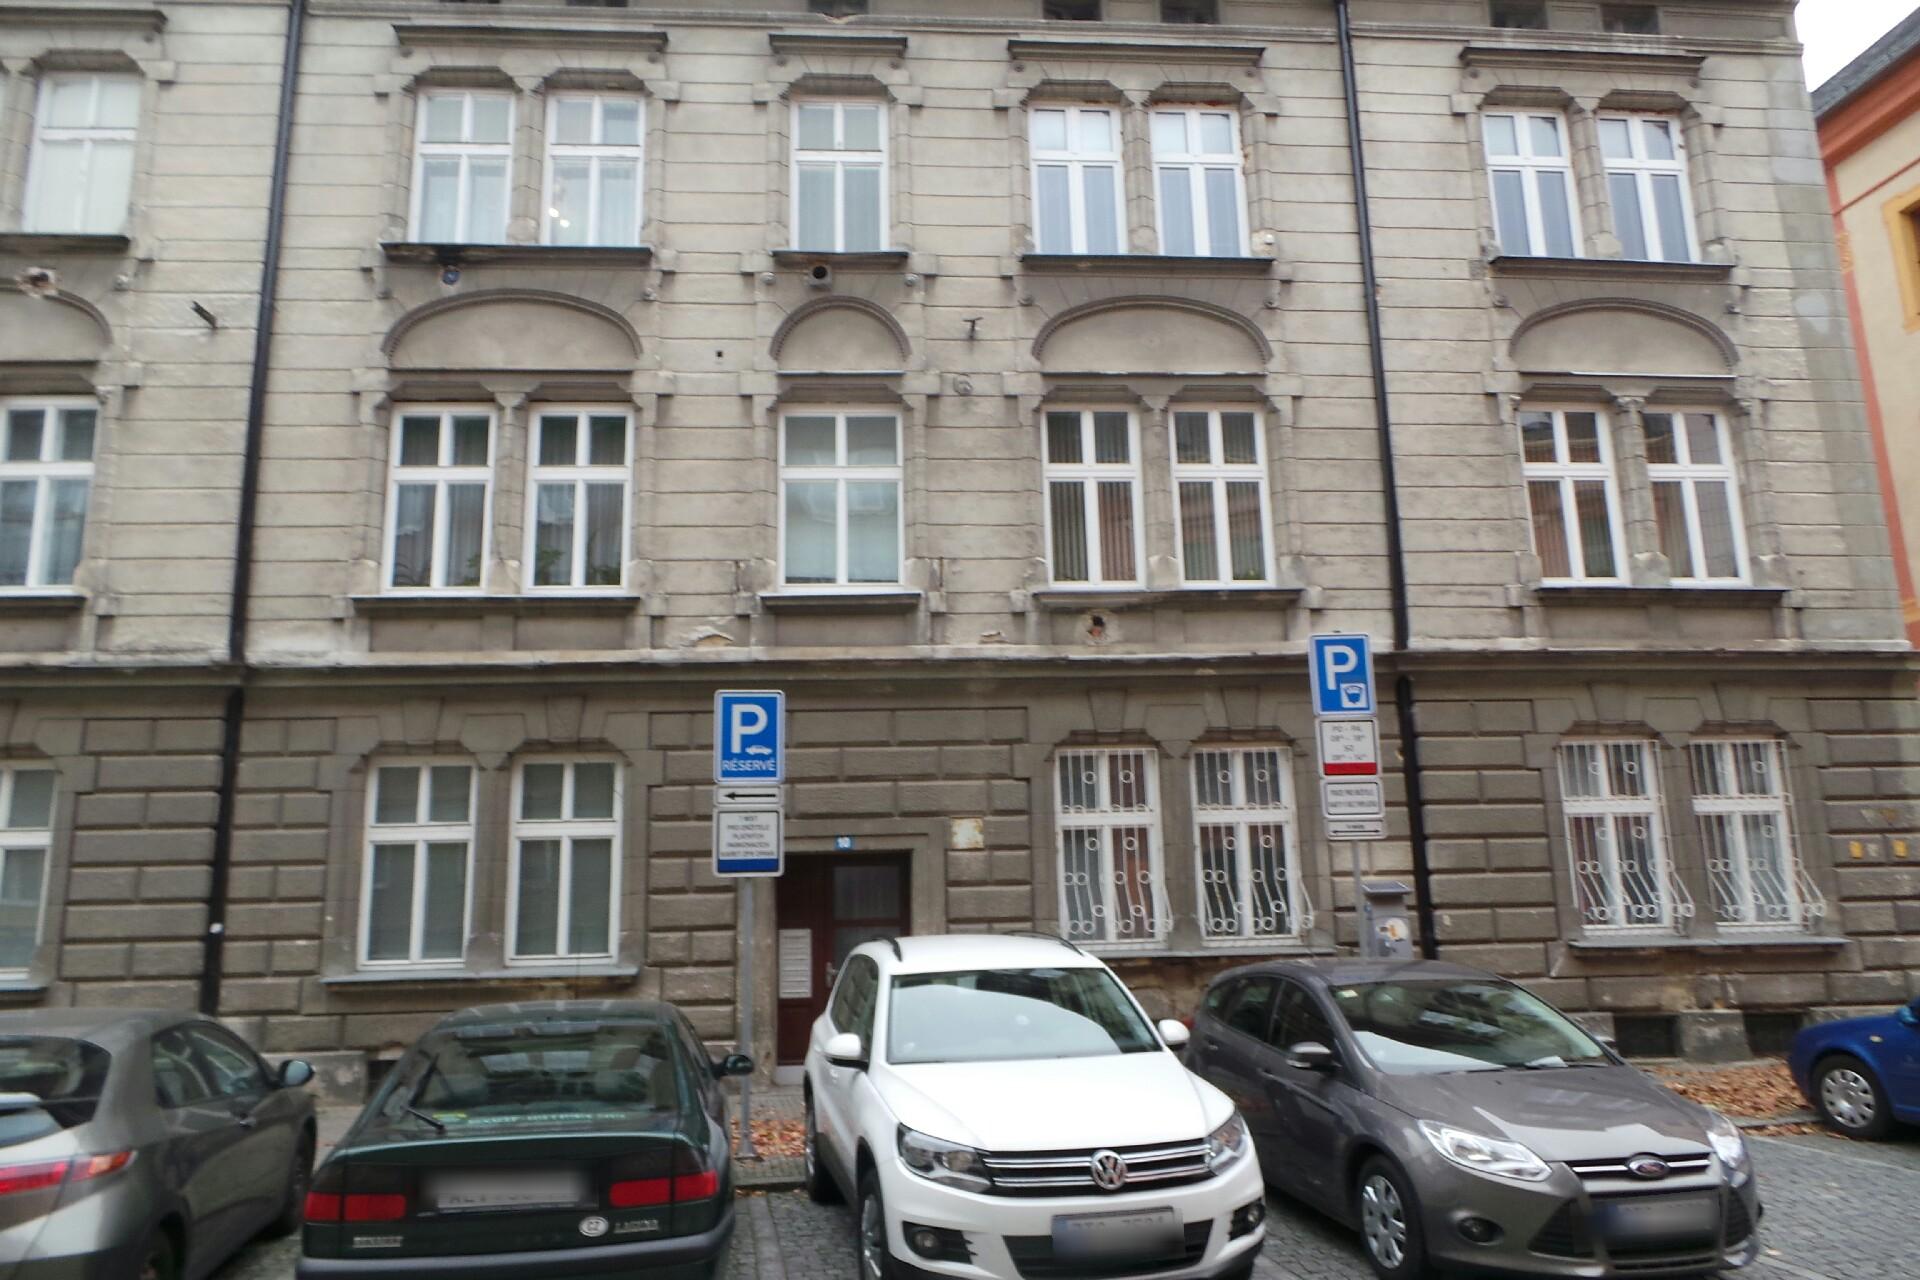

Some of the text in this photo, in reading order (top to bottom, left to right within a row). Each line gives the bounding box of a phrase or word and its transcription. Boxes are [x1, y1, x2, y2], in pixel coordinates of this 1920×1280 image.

[1323, 644, 1358, 691] P
[731, 703, 768, 754] P
[722, 757, 776, 772] RÉSERVÉ
